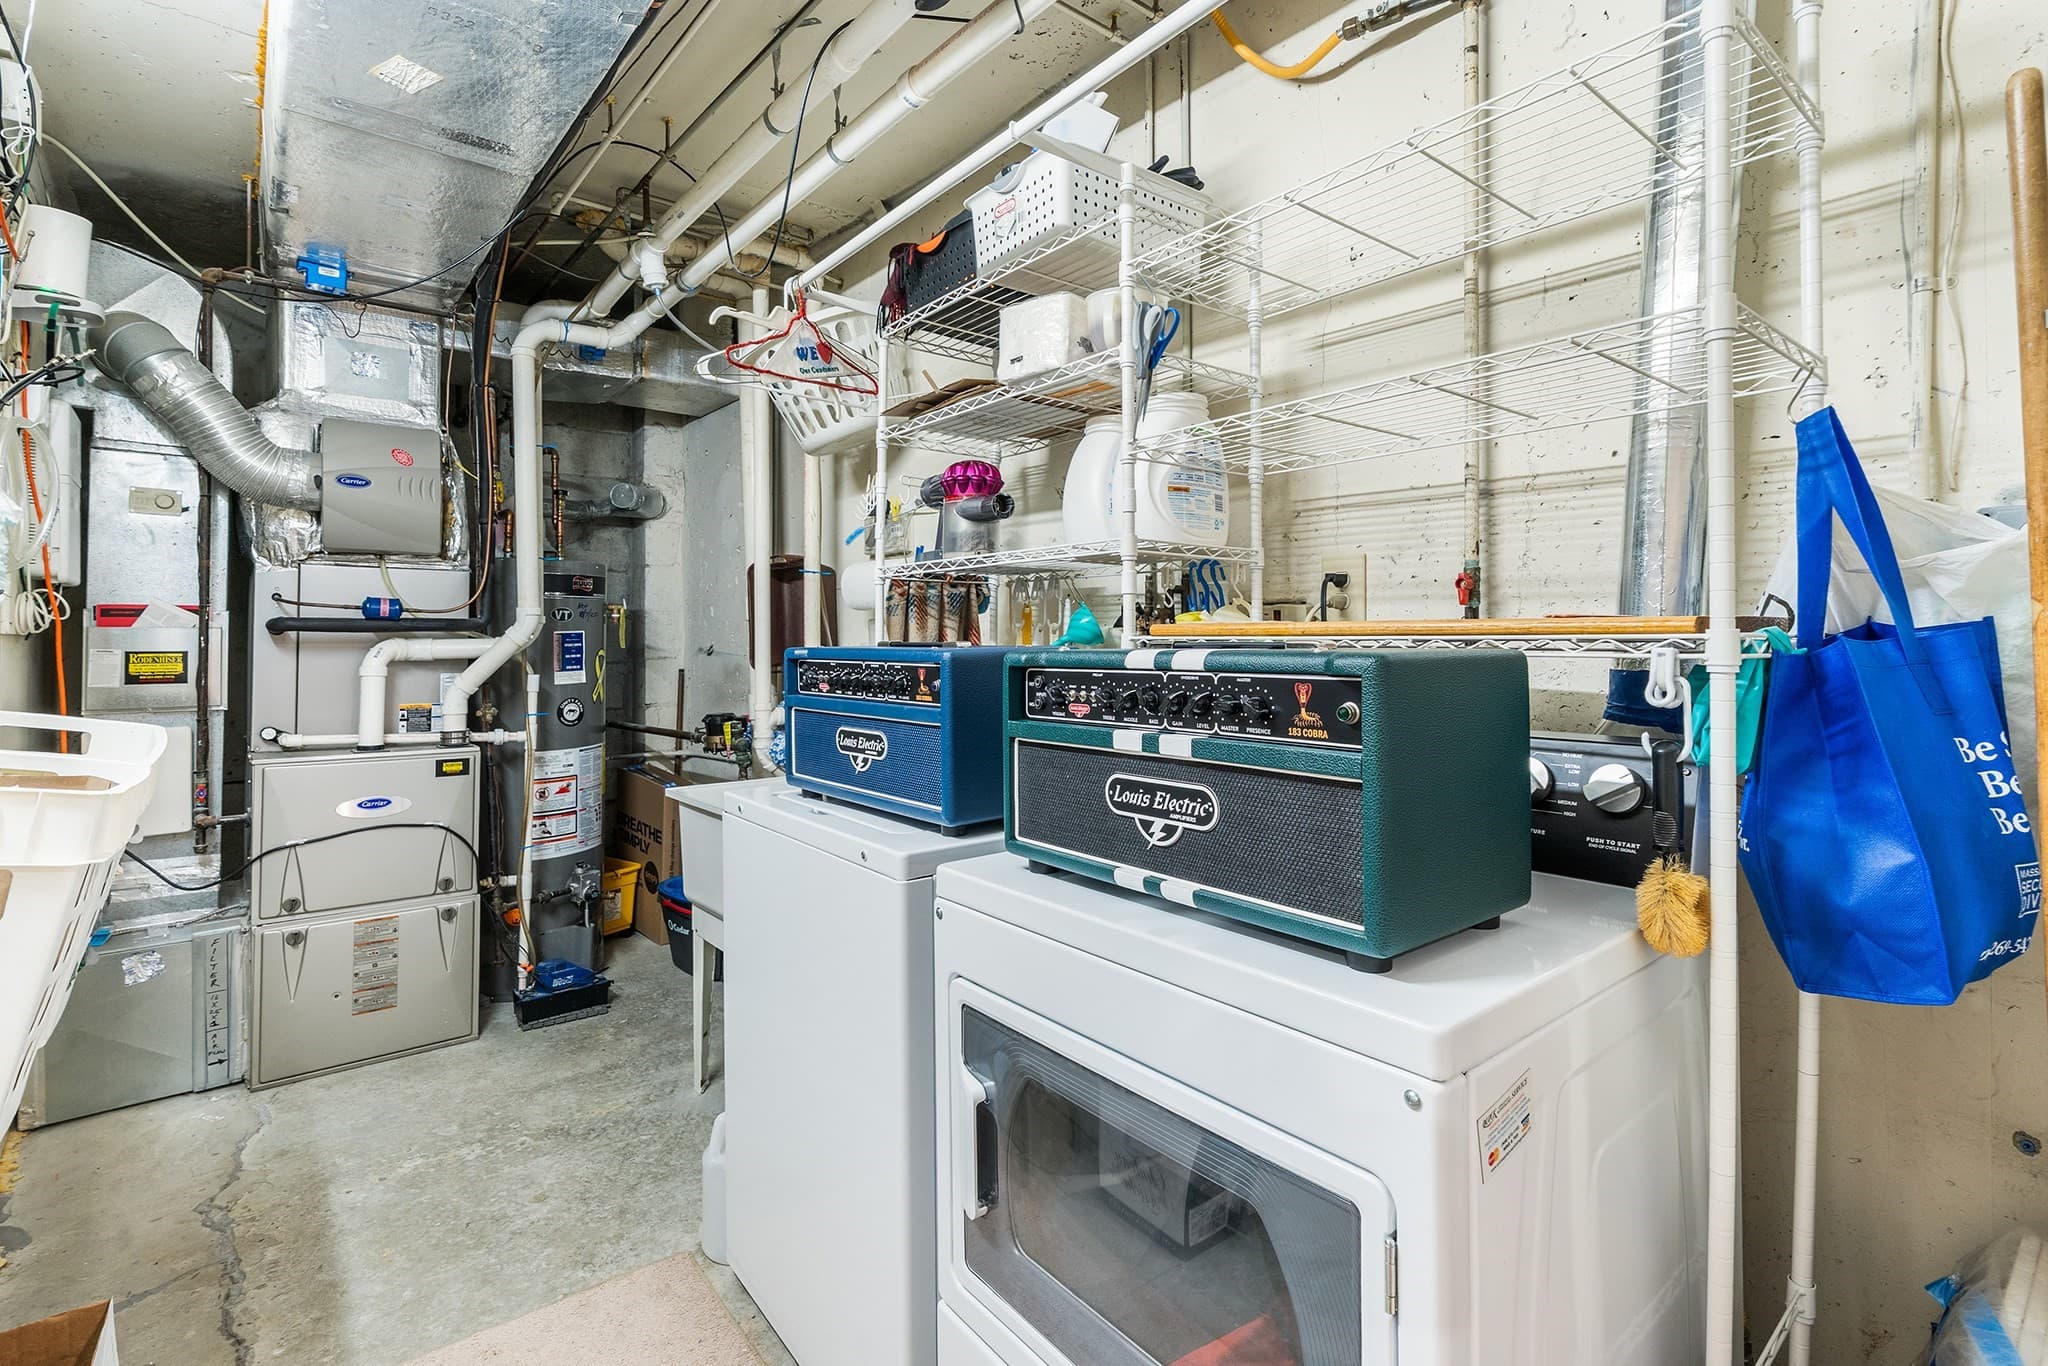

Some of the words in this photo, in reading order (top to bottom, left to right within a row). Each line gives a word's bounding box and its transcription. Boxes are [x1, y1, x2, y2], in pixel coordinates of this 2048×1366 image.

[796, 346, 819, 361] WE
[340, 477, 366, 486] Carrier
[554, 609, 571, 620] VT
[1246, 727, 1271, 735] PRESENCE
[1288, 727, 1302, 737] 183
[1303, 729, 1329, 740] COBRA
[839, 734, 858, 747] Louis
[858, 736, 884, 752] Electric
[1953, 736, 1998, 763] Be
[361, 800, 389, 808] Carrier
[1112, 785, 1151, 807] Louis
[1152, 791, 1210, 817] Electric
[1989, 807, 2031, 835] Be
[1586, 836, 1605, 844] PUSH
[1617, 841, 1640, 850] START
